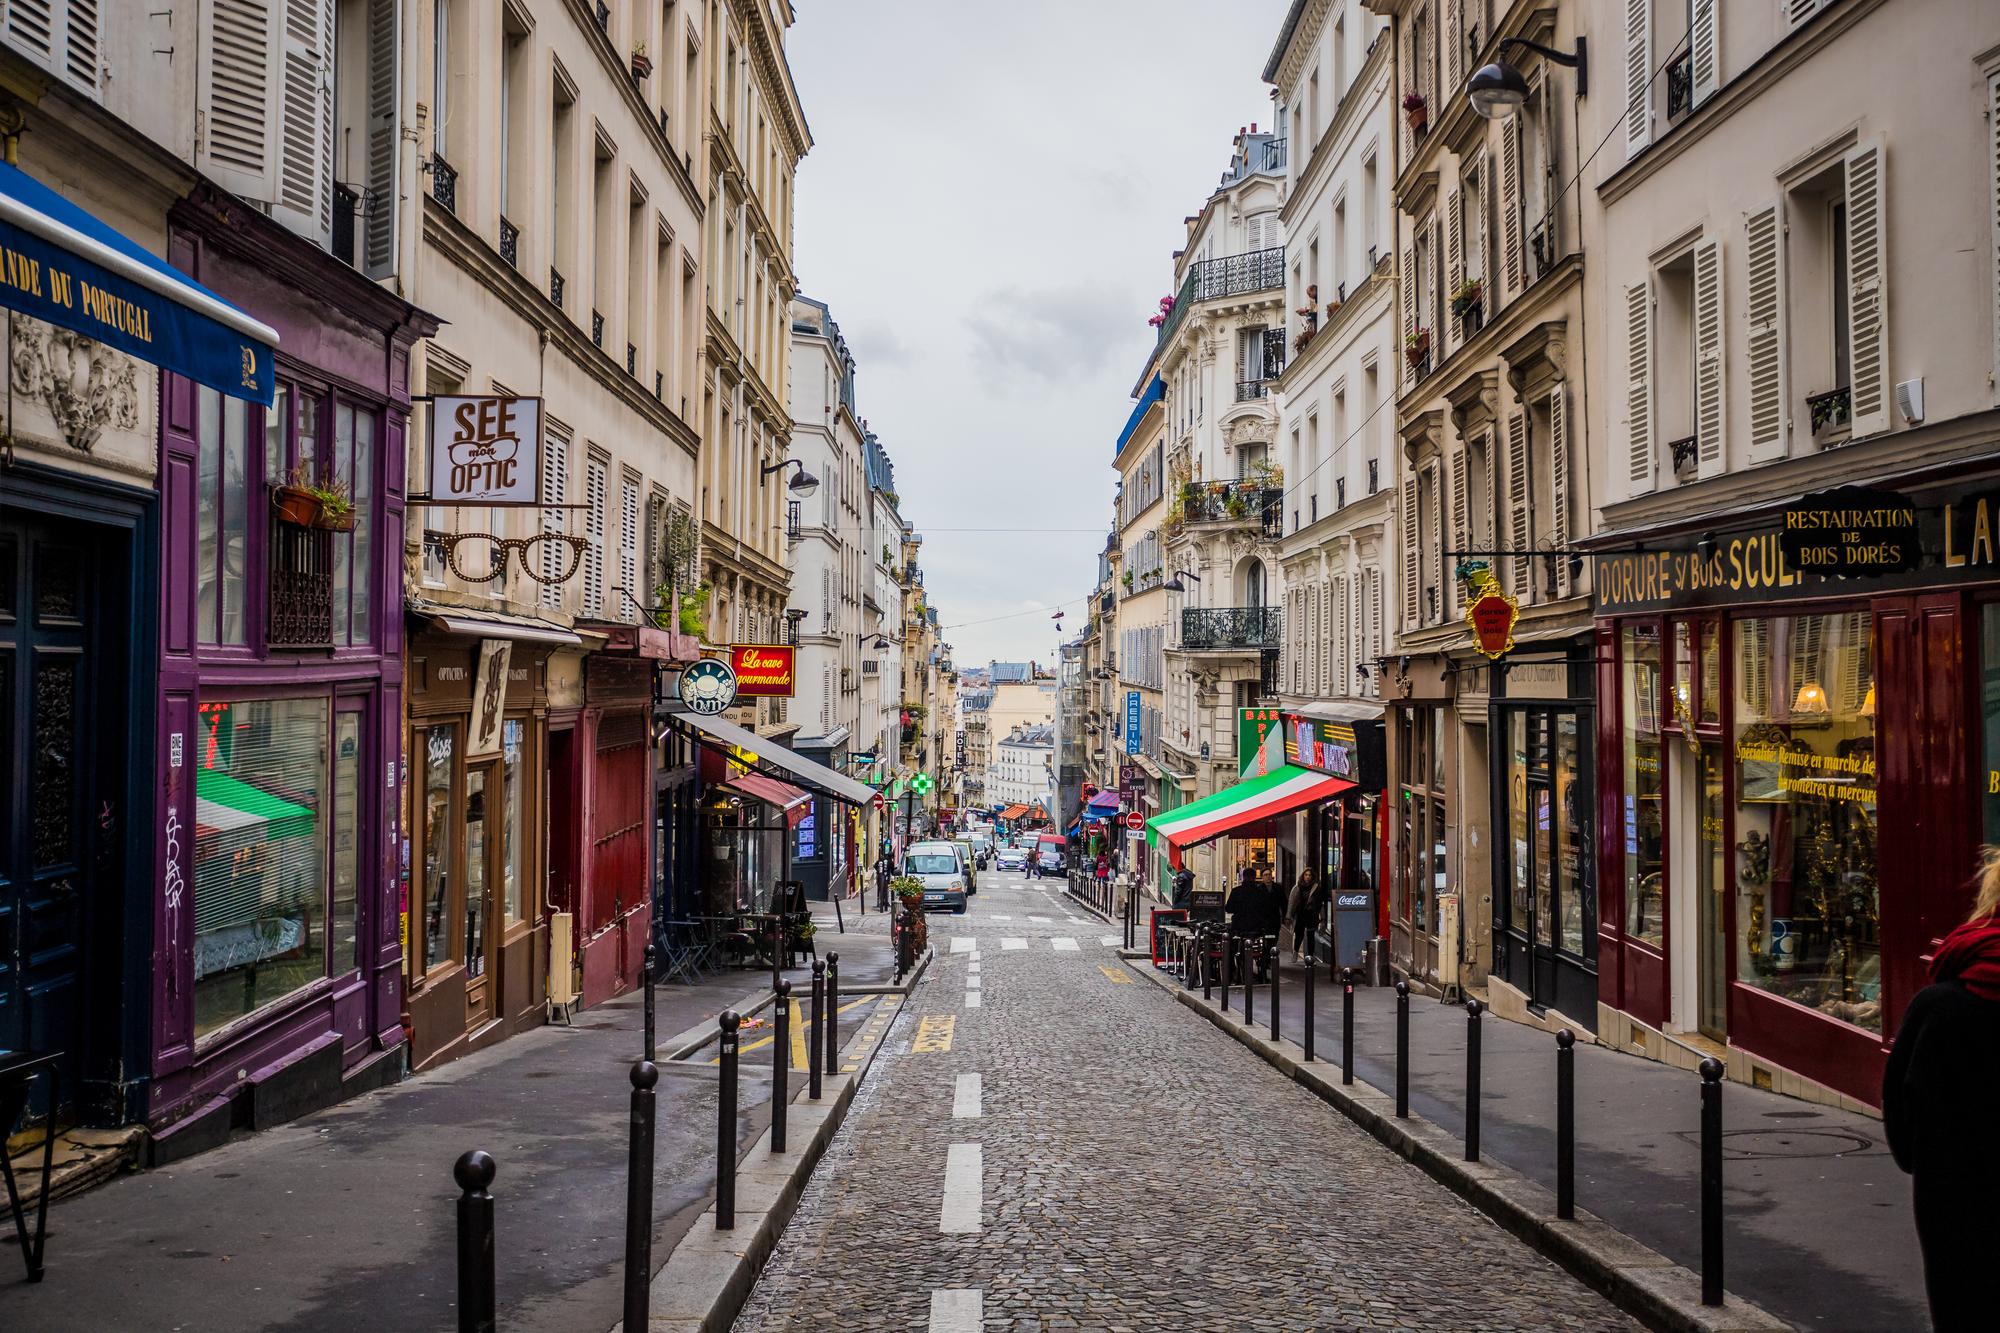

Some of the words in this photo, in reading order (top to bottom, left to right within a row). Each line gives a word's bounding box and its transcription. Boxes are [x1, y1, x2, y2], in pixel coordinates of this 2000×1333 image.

[49, 267, 72, 309] DU
[81, 280, 152, 343] PORTUGAL
[454, 399, 517, 442] SEE
[468, 445, 496, 457] mon
[451, 458, 517, 494] OPTIC
[1787, 508, 1914, 529] RESTAURATION
[1842, 532, 1861, 543] DE
[1945, 498, 2000, 568] LA
[1800, 547, 1838, 565] BOIS
[1846, 540, 1901, 565] DORÉS
[1600, 551, 1671, 606] DORURE
[741, 648, 761, 669] La
[761, 658, 784, 669] cave
[736, 671, 791, 687] gourmande
[1129, 692, 1138, 754] PRESSING
[1245, 710, 1279, 720] BAR
[956, 731, 964, 767] HOTEL
[1778, 746, 1808, 766] Remise
[1811, 754, 1822, 768] en
[1823, 753, 1860, 773] marche
